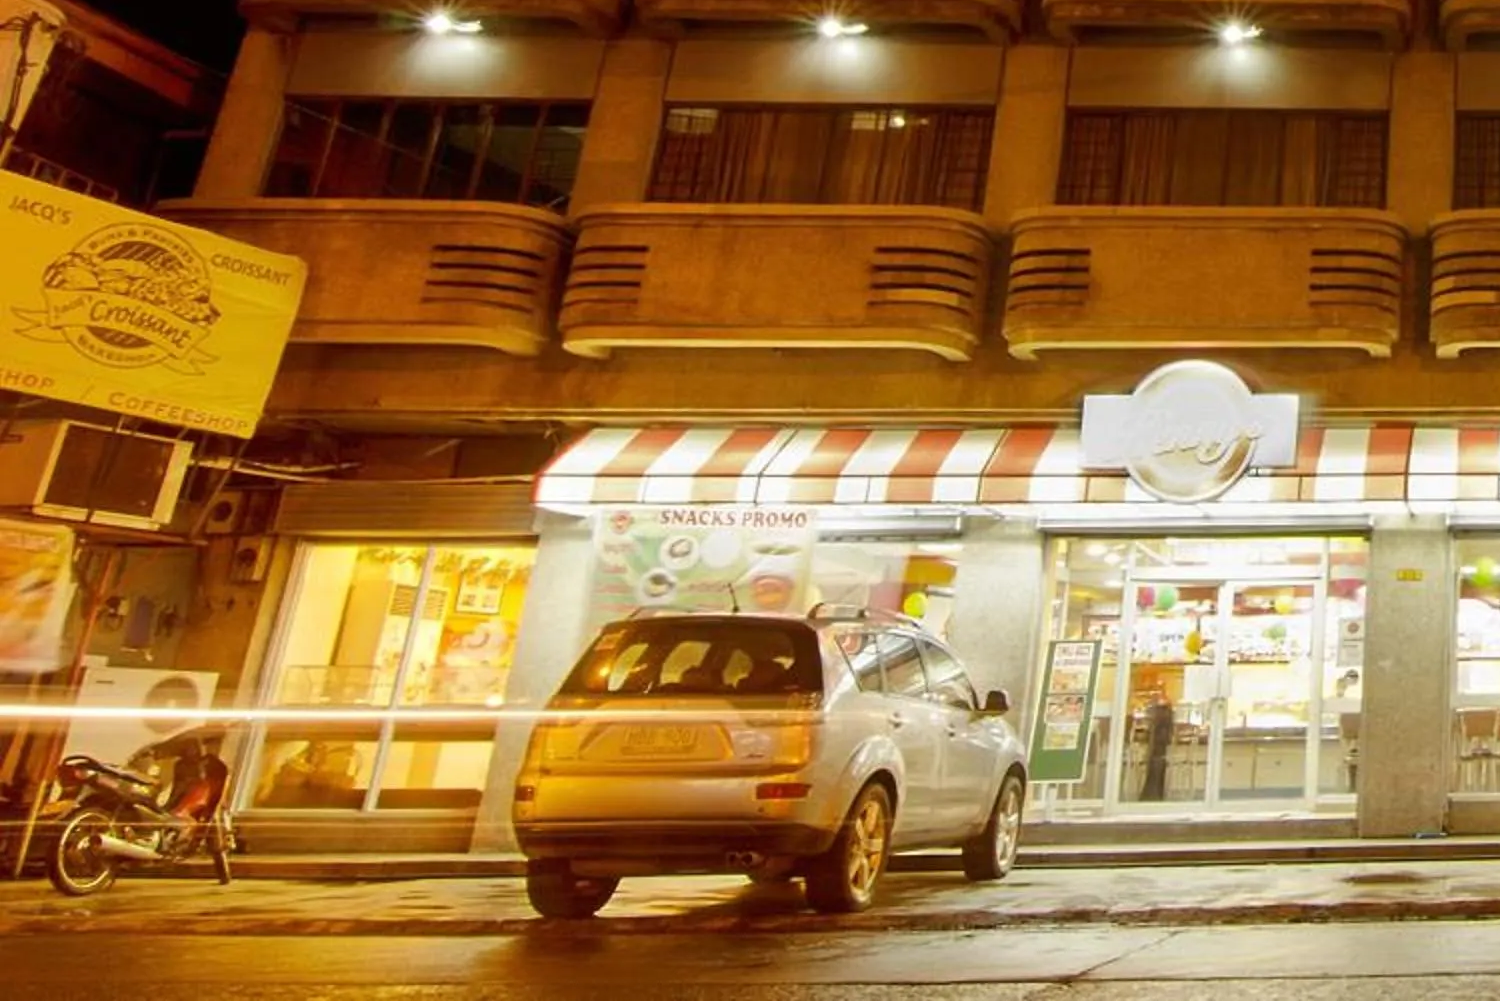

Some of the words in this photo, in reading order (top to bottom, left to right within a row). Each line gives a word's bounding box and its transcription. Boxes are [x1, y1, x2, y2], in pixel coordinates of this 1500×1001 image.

[8, 195, 73, 225] JACQ'S
[210, 253, 292, 288] CROISSANT
[89, 299, 192, 349] Croissant
[109, 392, 248, 431] COFFEESHOP
[660, 510, 736, 527] SNACKS
[741, 511, 808, 529] PROMO
